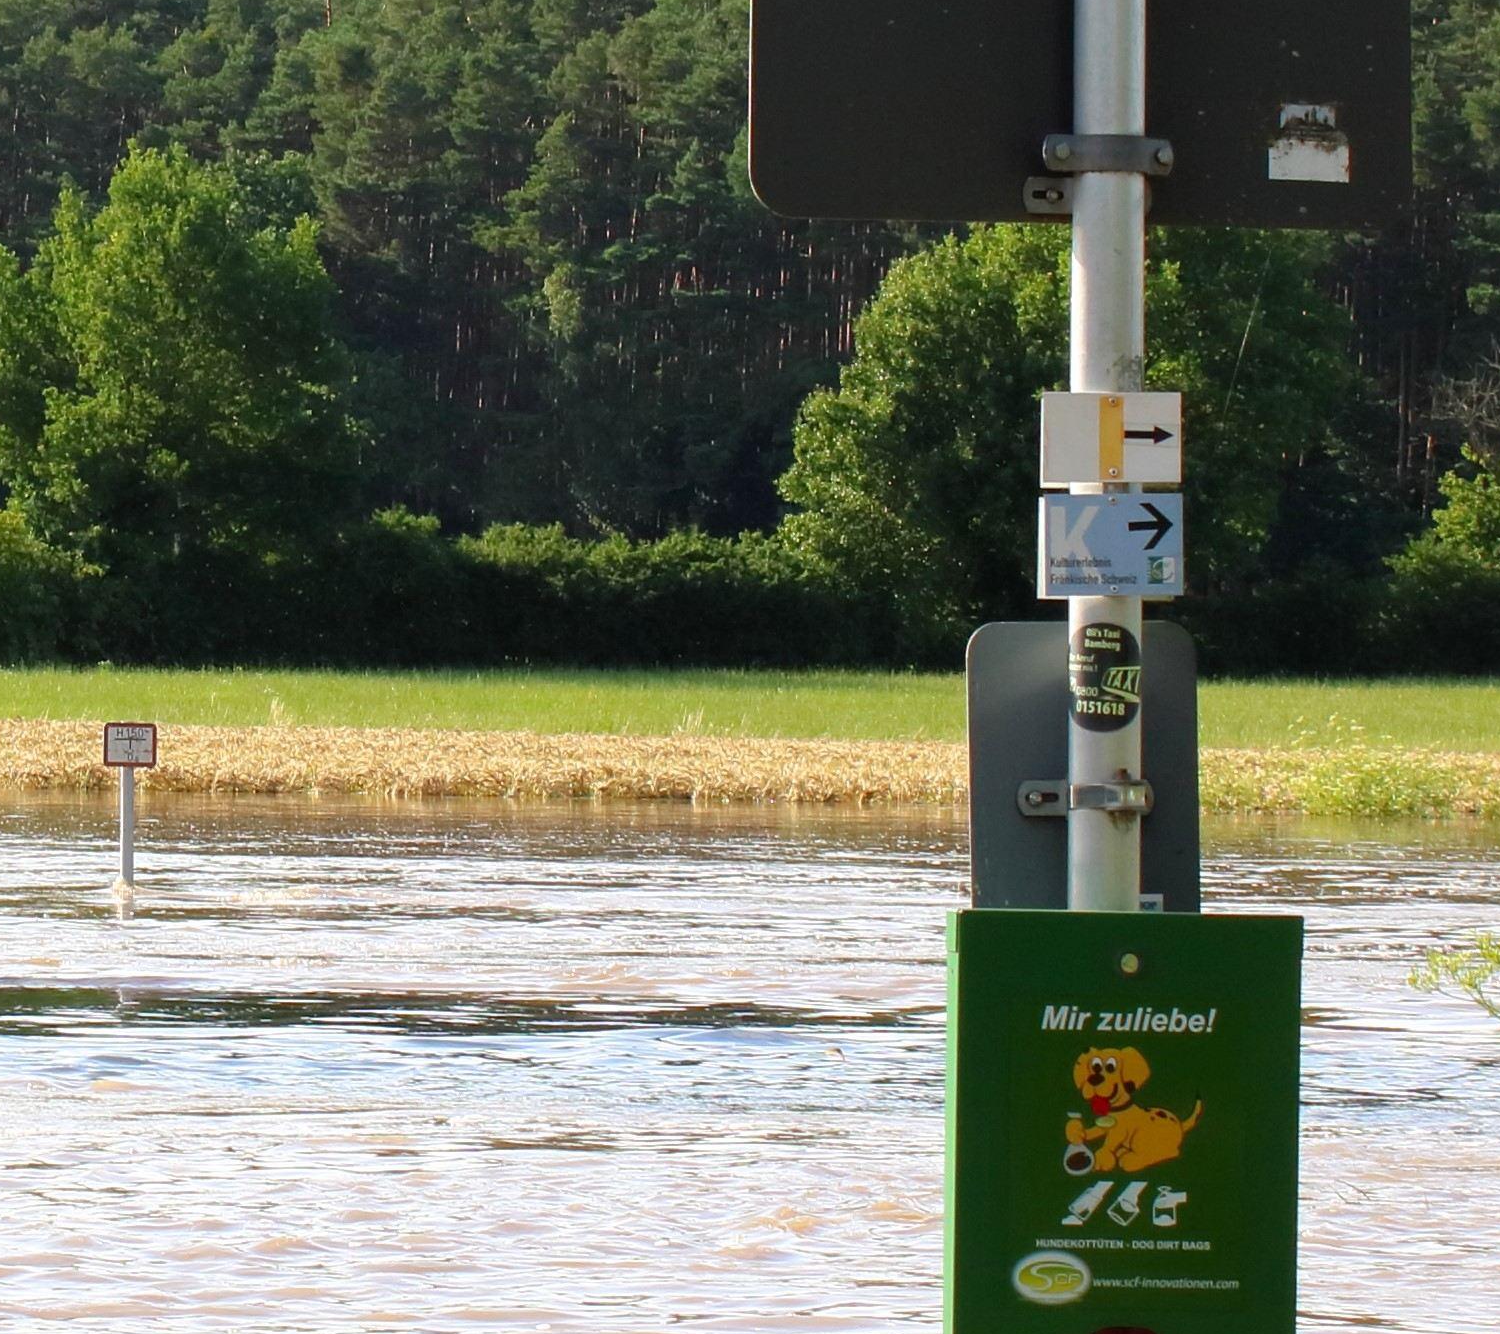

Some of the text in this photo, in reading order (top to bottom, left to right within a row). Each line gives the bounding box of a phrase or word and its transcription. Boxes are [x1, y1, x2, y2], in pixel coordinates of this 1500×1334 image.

[1050, 506, 1102, 583] K
[1050, 556, 1112, 568] Kulturerlebnis
[1050, 574, 1137, 585] Fränkische Schweiz
[1084, 639, 1121, 652] Bamberg
[1107, 669, 1141, 694] TAXI
[1076, 699, 1126, 716] 0151618
[1041, 1004, 1218, 1033] Mir zuliebe!
[1036, 1238, 1124, 1250] HUNDEKOTTÜTEN
[1132, 1240, 1154, 1250] DOG
[1157, 1240, 1179, 1250] DIRT
[1182, 1241, 1211, 1251] BAGS
[1092, 1275, 1240, 1290] www.scf-innovationen.com
